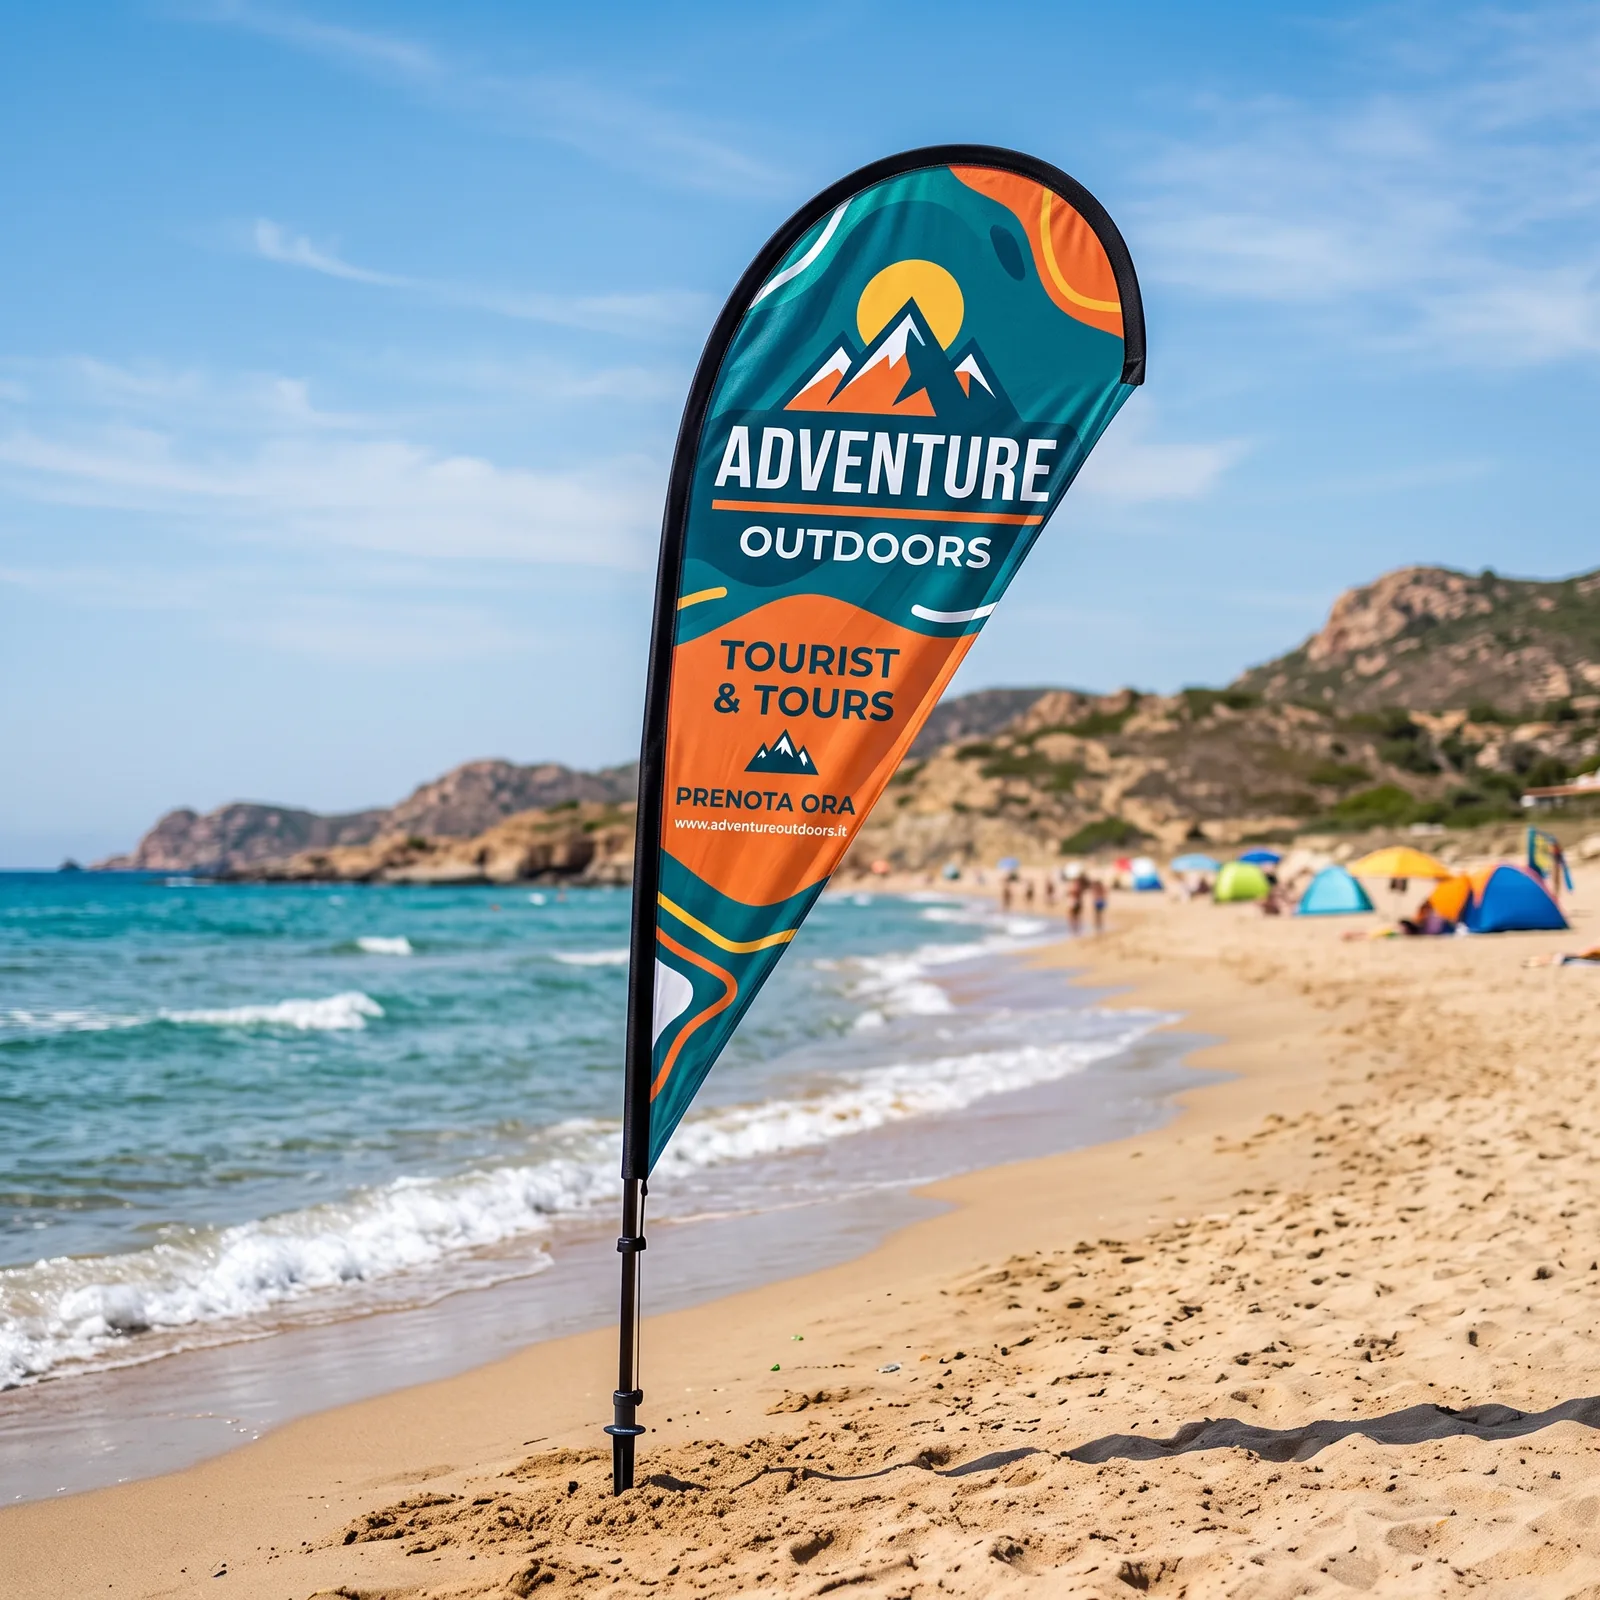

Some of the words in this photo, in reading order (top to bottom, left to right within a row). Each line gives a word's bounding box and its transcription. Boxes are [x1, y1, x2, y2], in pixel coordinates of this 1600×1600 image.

[714, 425, 1057, 502] ADVENTURE
[739, 525, 992, 569] OUTDOORS
[720, 639, 900, 678] TOURIST
[713, 682, 740, 714] &
[753, 684, 894, 722] TOURS
[675, 787, 794, 812] PRENOTA
[801, 793, 856, 815] ORA
[674, 818, 848, 837] www.adventureoutdoors.it
